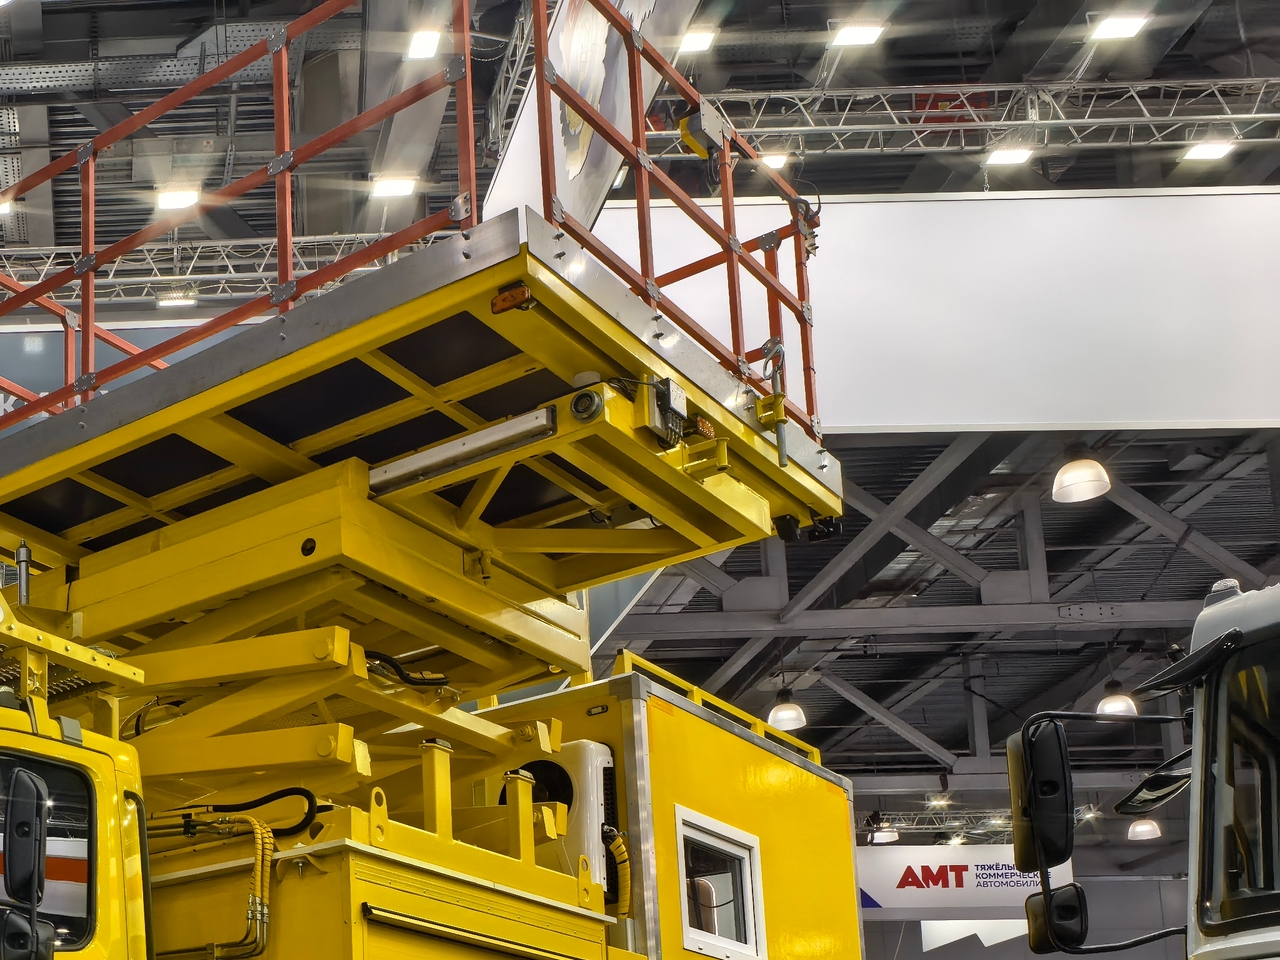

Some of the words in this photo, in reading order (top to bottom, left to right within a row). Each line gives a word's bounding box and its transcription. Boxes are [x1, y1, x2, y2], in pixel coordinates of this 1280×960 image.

[974, 862, 1017, 872] ТЯЖЁЛЫ
[895, 864, 969, 889] АМТ
[975, 872, 1052, 880] КОММЕРЧЕСКЕ
